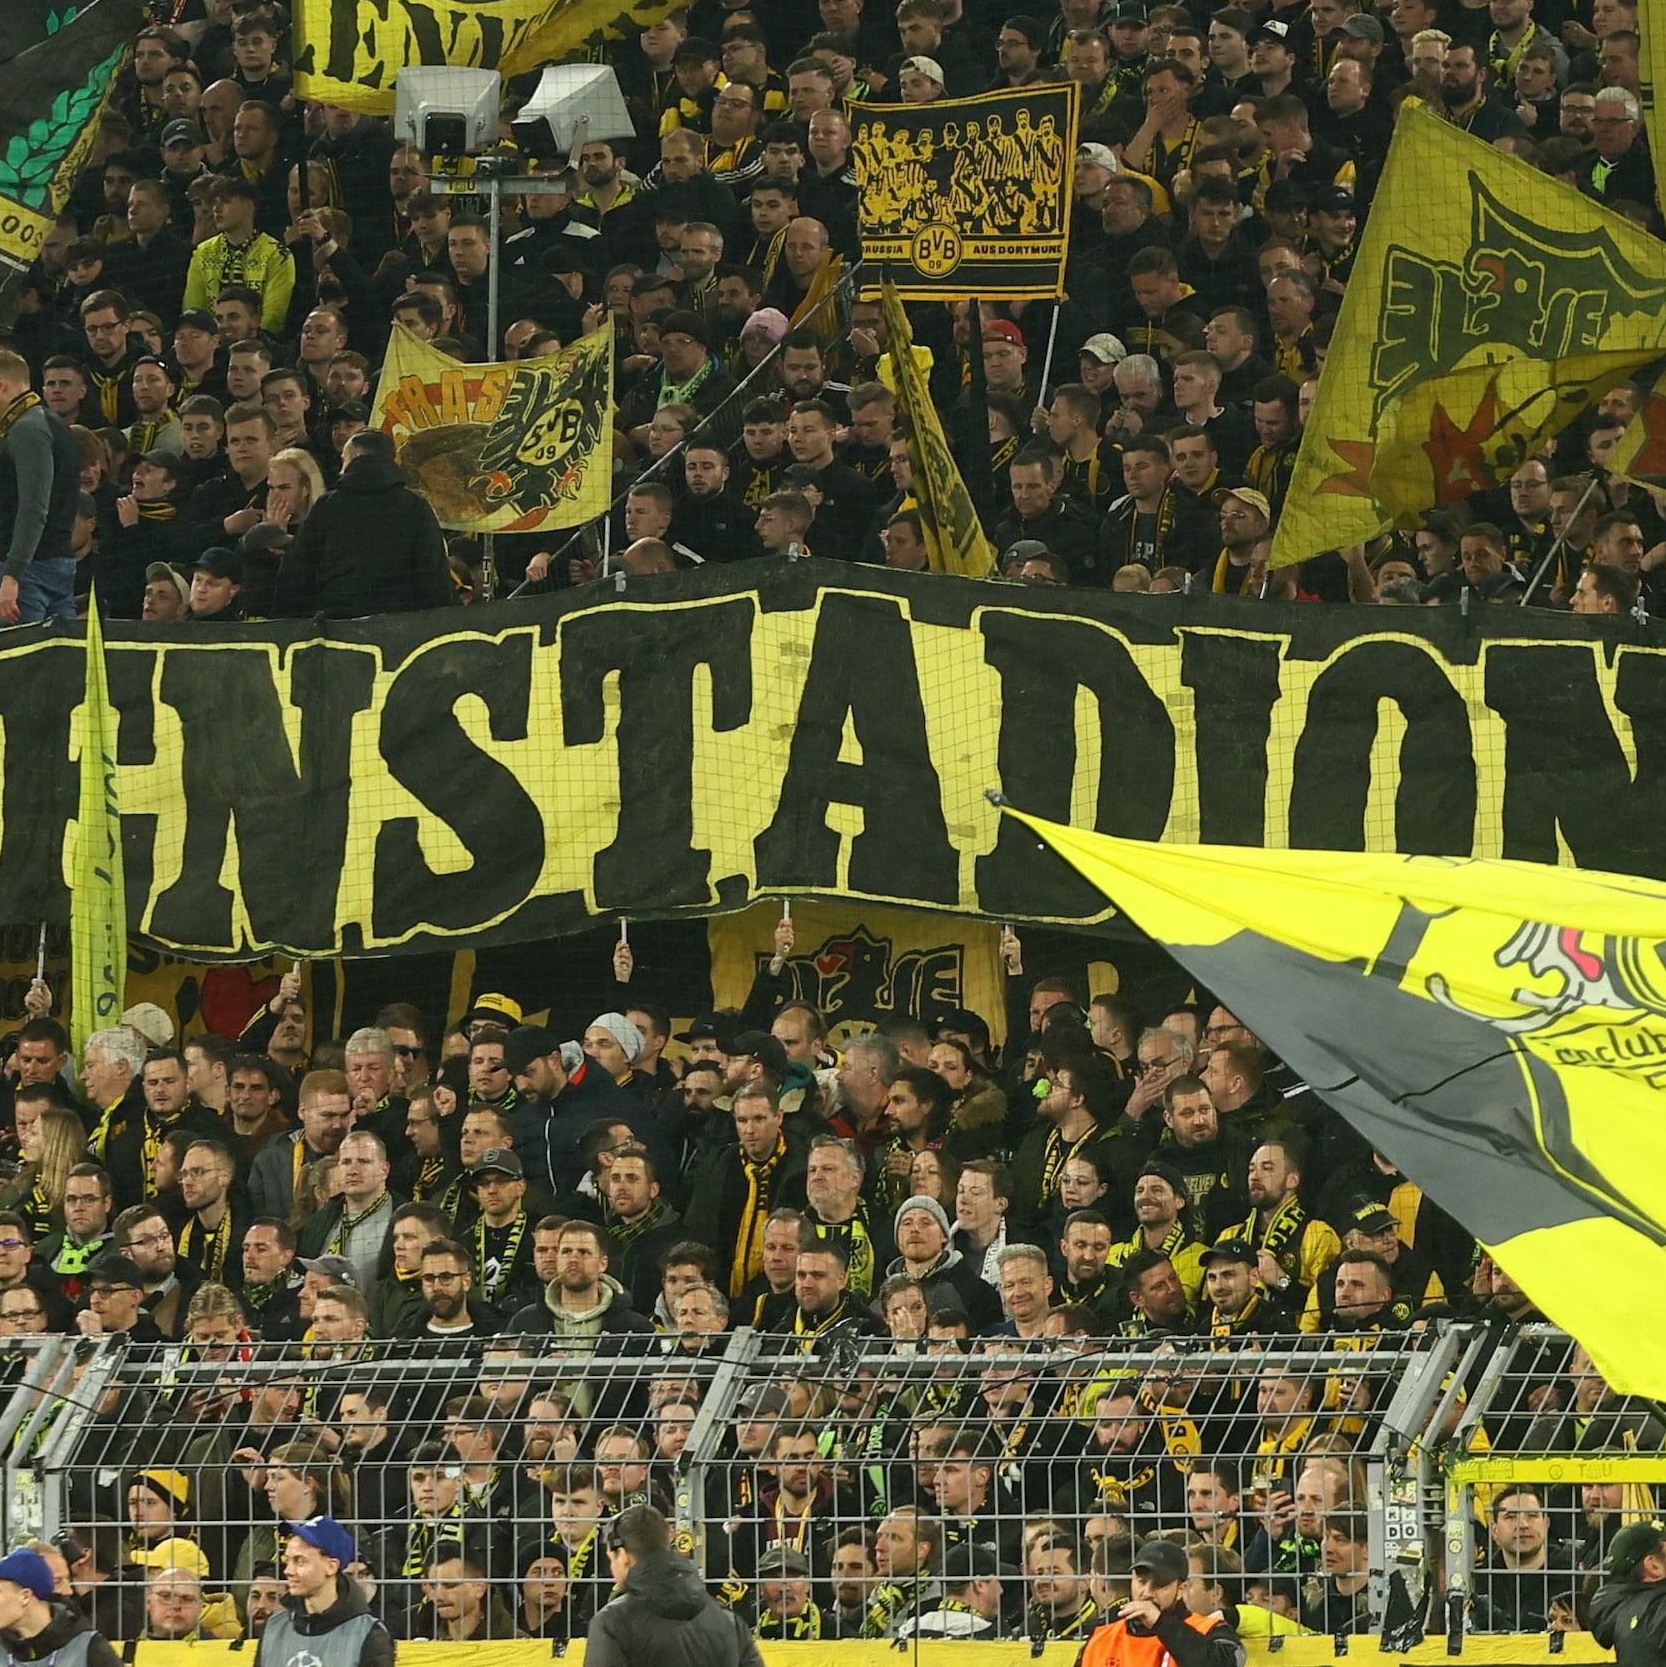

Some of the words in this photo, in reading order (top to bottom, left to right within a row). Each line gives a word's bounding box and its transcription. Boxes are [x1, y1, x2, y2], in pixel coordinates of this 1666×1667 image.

[919, 230, 956, 259] BVB
[928, 260, 942, 270] 09
[535, 445, 556, 461] 09
